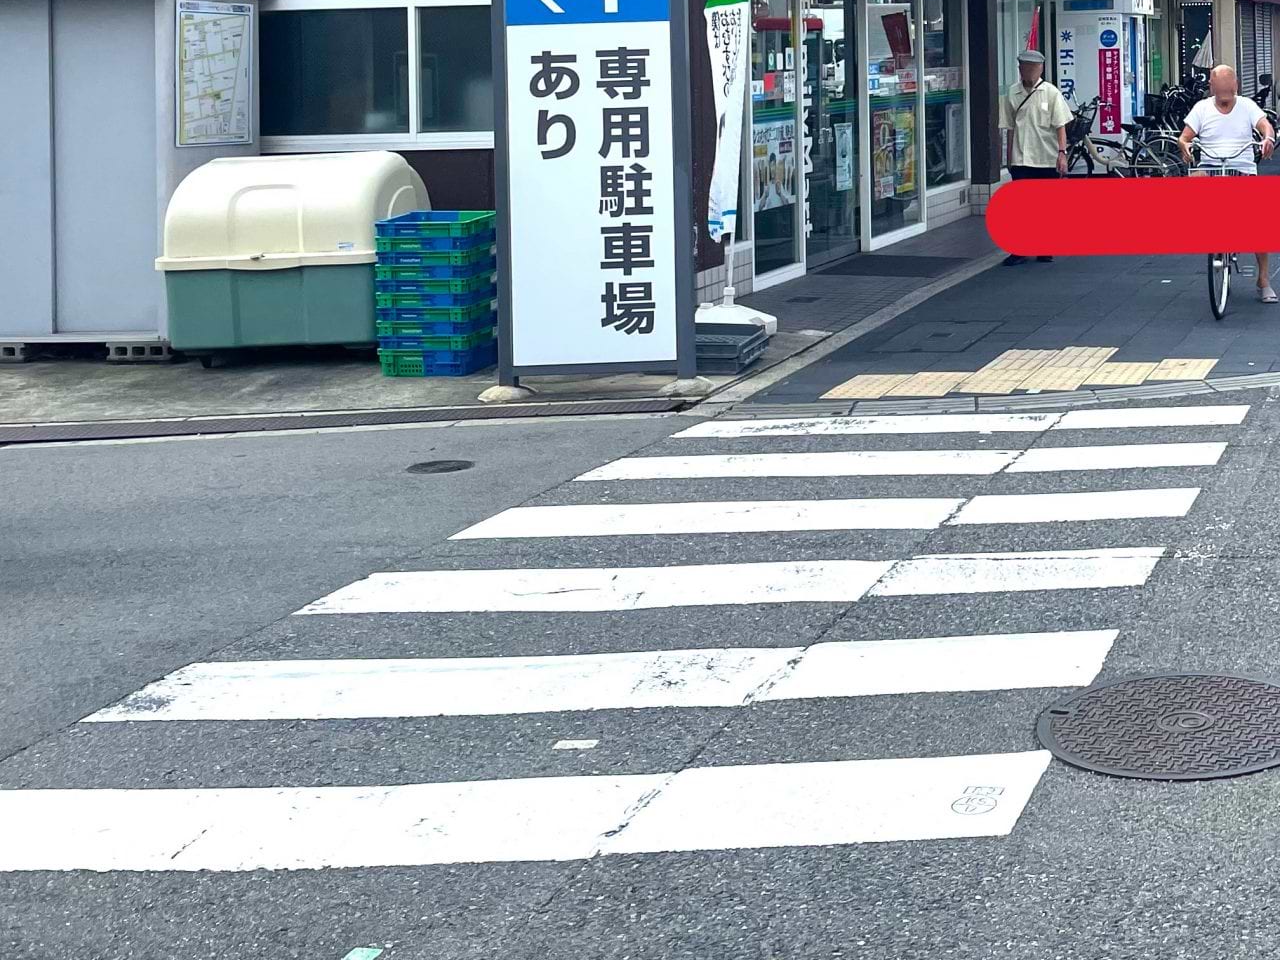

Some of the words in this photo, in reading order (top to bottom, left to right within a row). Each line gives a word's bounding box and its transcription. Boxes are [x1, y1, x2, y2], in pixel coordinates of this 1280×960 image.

[528, 50, 580, 161] あり
[594, 46, 656, 336] 専用駐車場
